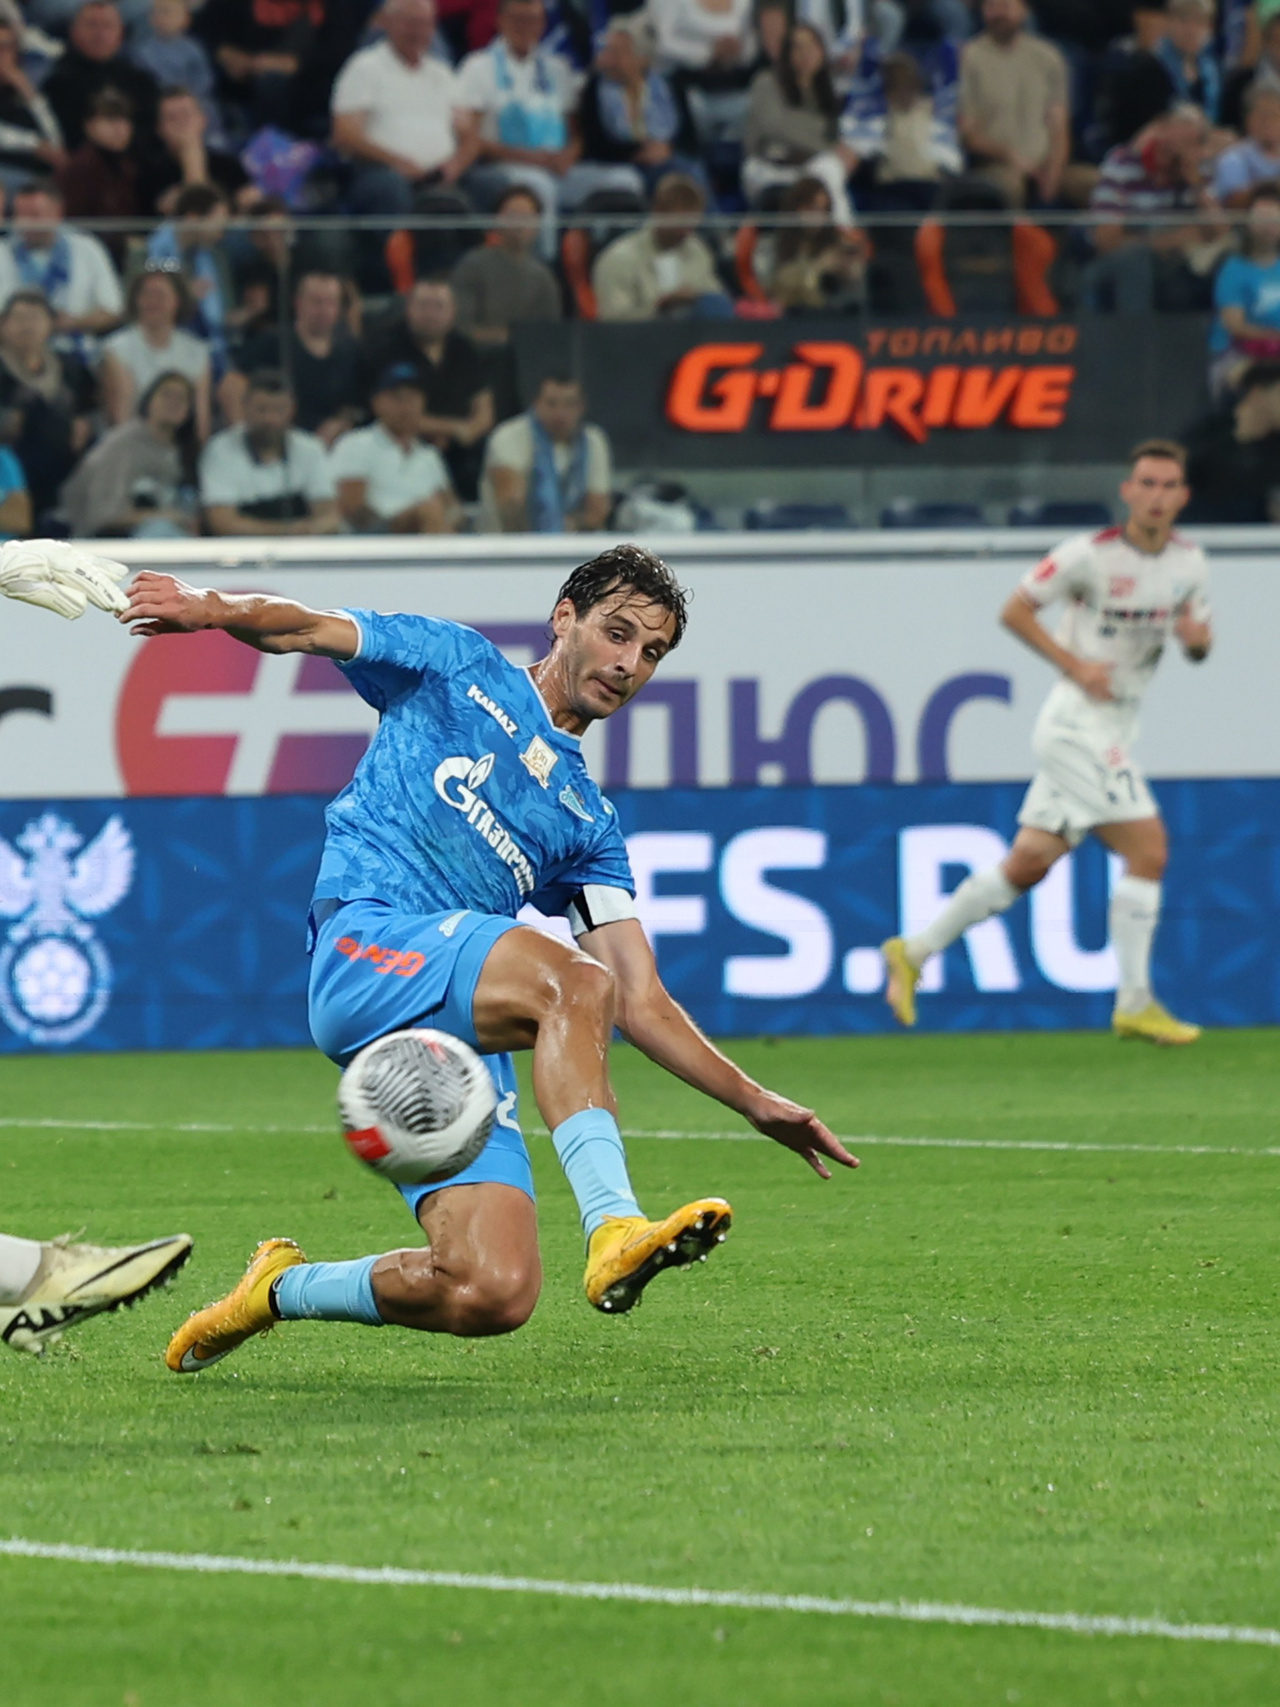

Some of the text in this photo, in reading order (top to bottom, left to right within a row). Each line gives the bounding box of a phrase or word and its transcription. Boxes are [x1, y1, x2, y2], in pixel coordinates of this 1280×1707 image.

[865, 325, 1079, 357] ТОПЛИВО
[467, 684, 519, 738] KAMAZ
[517, 823, 1120, 1002] FS.RU
